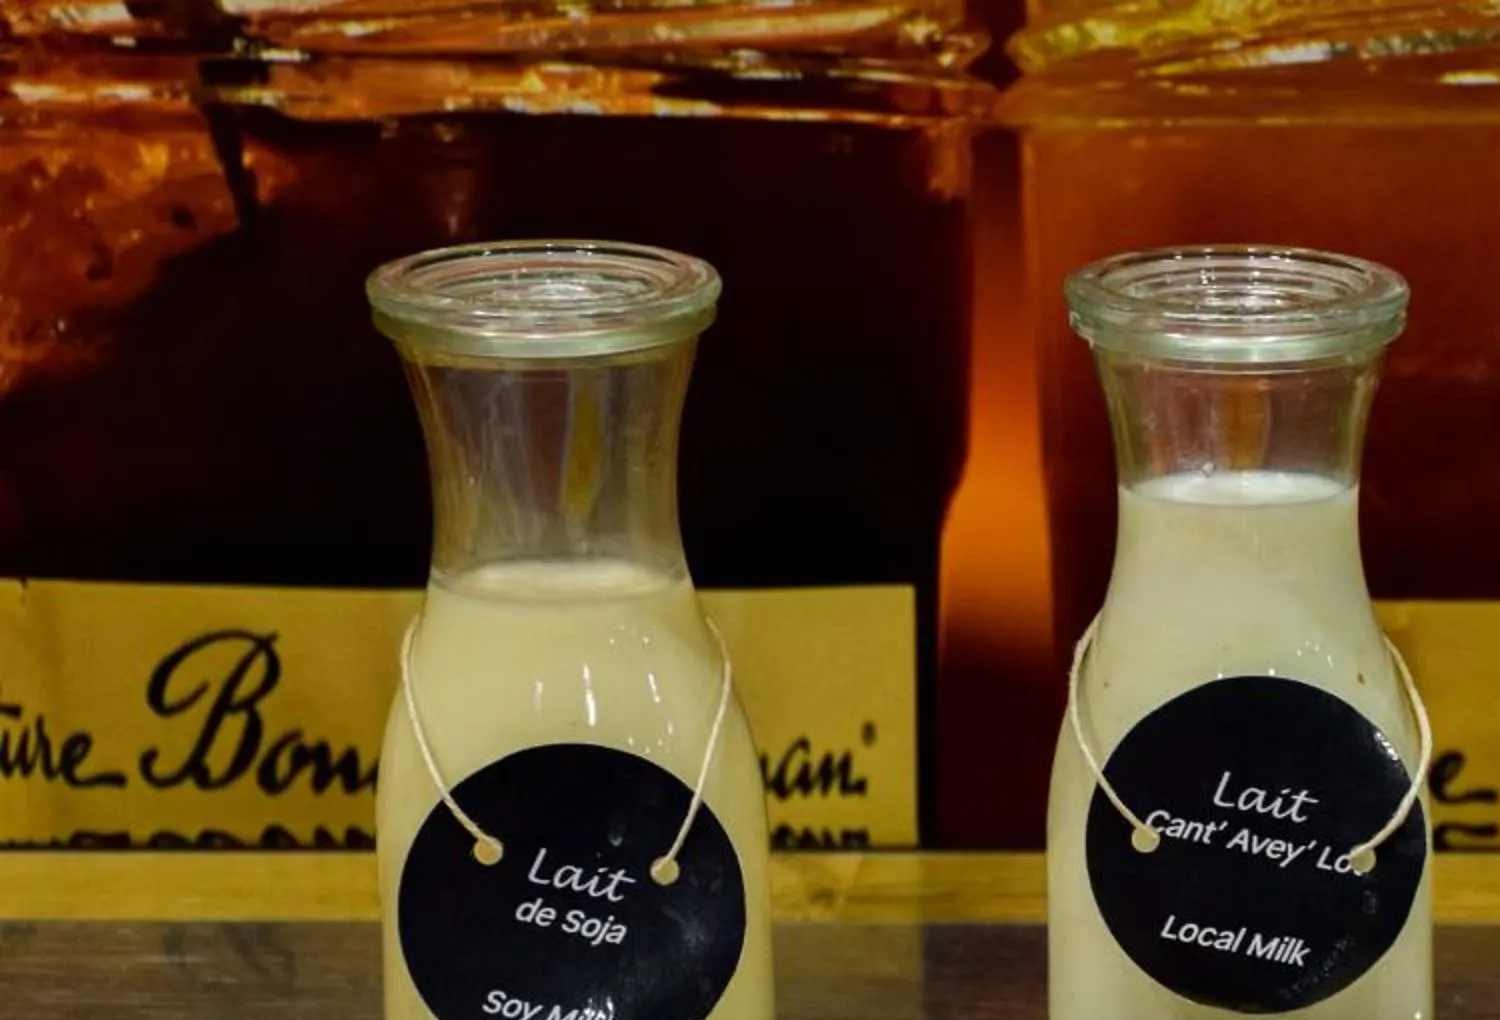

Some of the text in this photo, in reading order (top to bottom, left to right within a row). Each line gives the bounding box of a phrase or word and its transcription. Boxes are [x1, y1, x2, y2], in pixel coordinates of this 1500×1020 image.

[1213, 770, 1319, 823] Lait
[527, 847, 637, 902] Lait
[1315, 846, 1362, 877] Lo
[514, 898, 628, 947] de Soja
[1160, 914, 1312, 967] Local Milk
